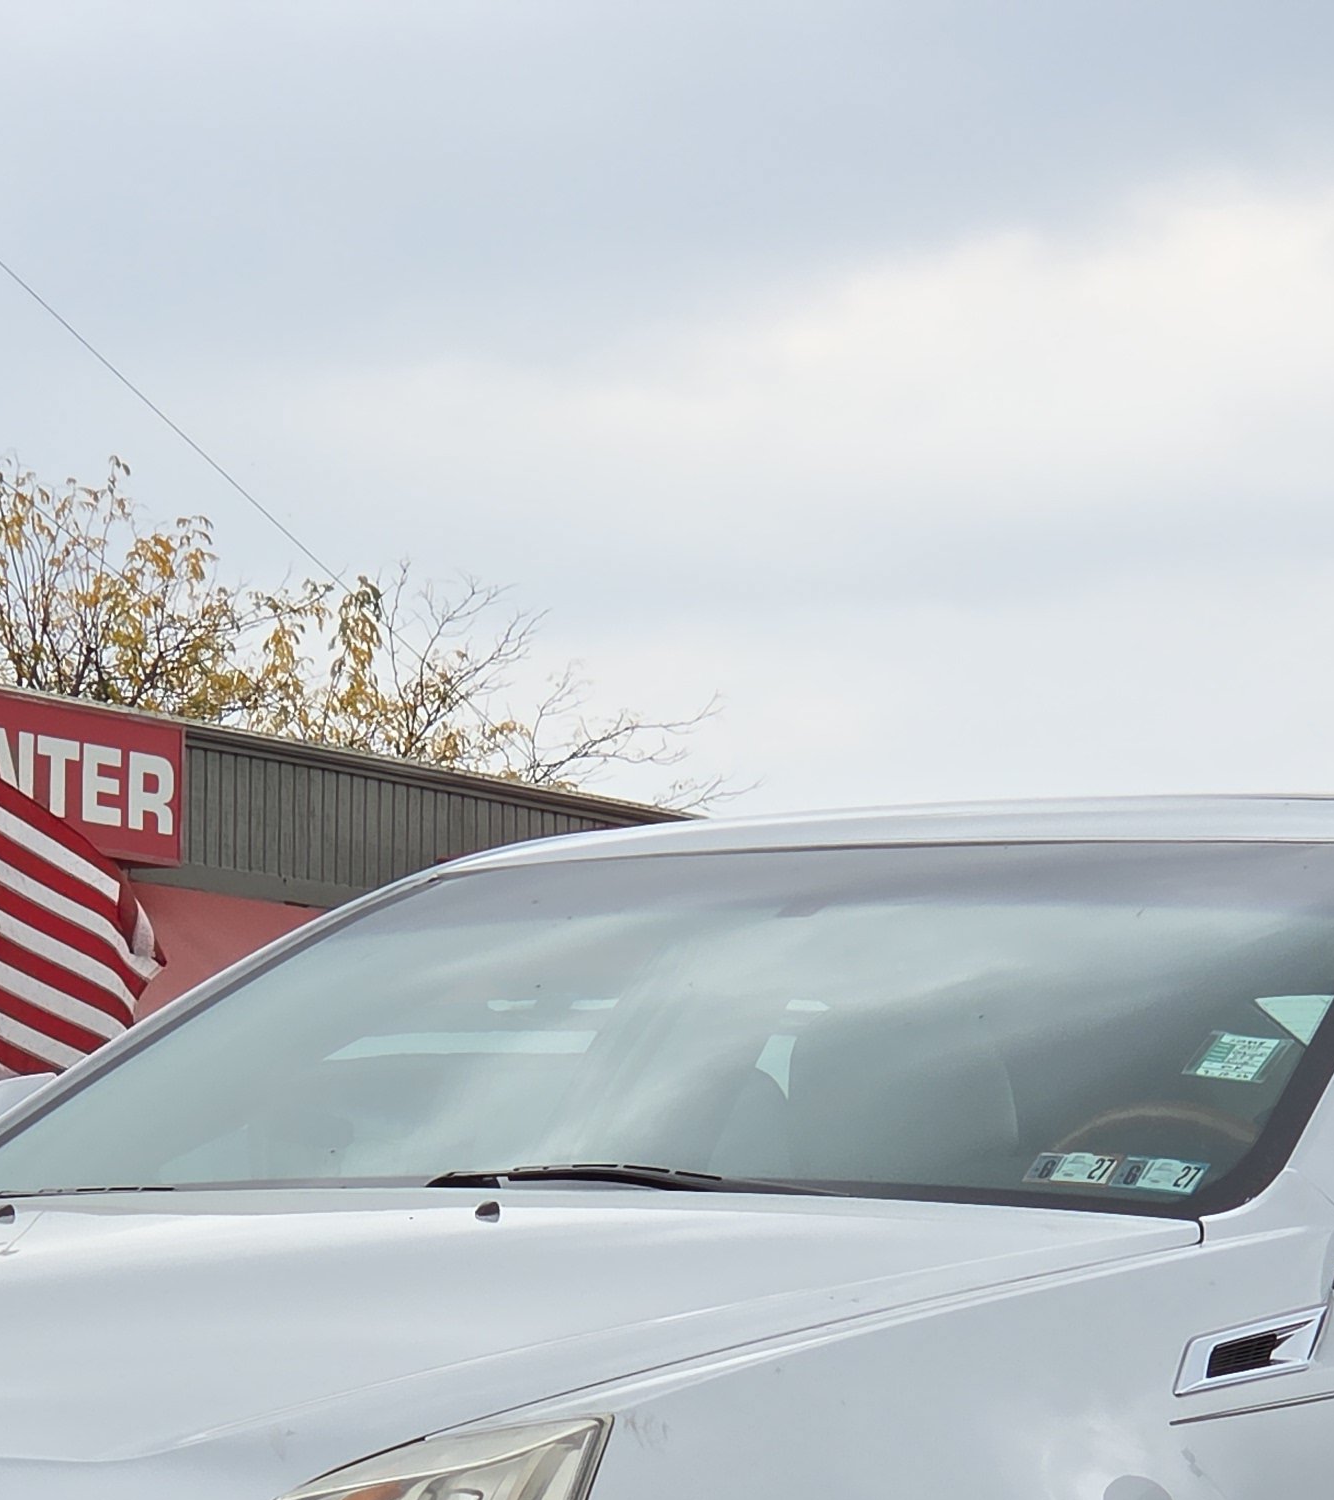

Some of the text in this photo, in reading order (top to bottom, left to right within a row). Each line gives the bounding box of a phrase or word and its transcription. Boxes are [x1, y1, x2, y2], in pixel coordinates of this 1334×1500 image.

[1087, 1158, 1116, 1181] 27
[1123, 1165, 1202, 1190] 6 27
